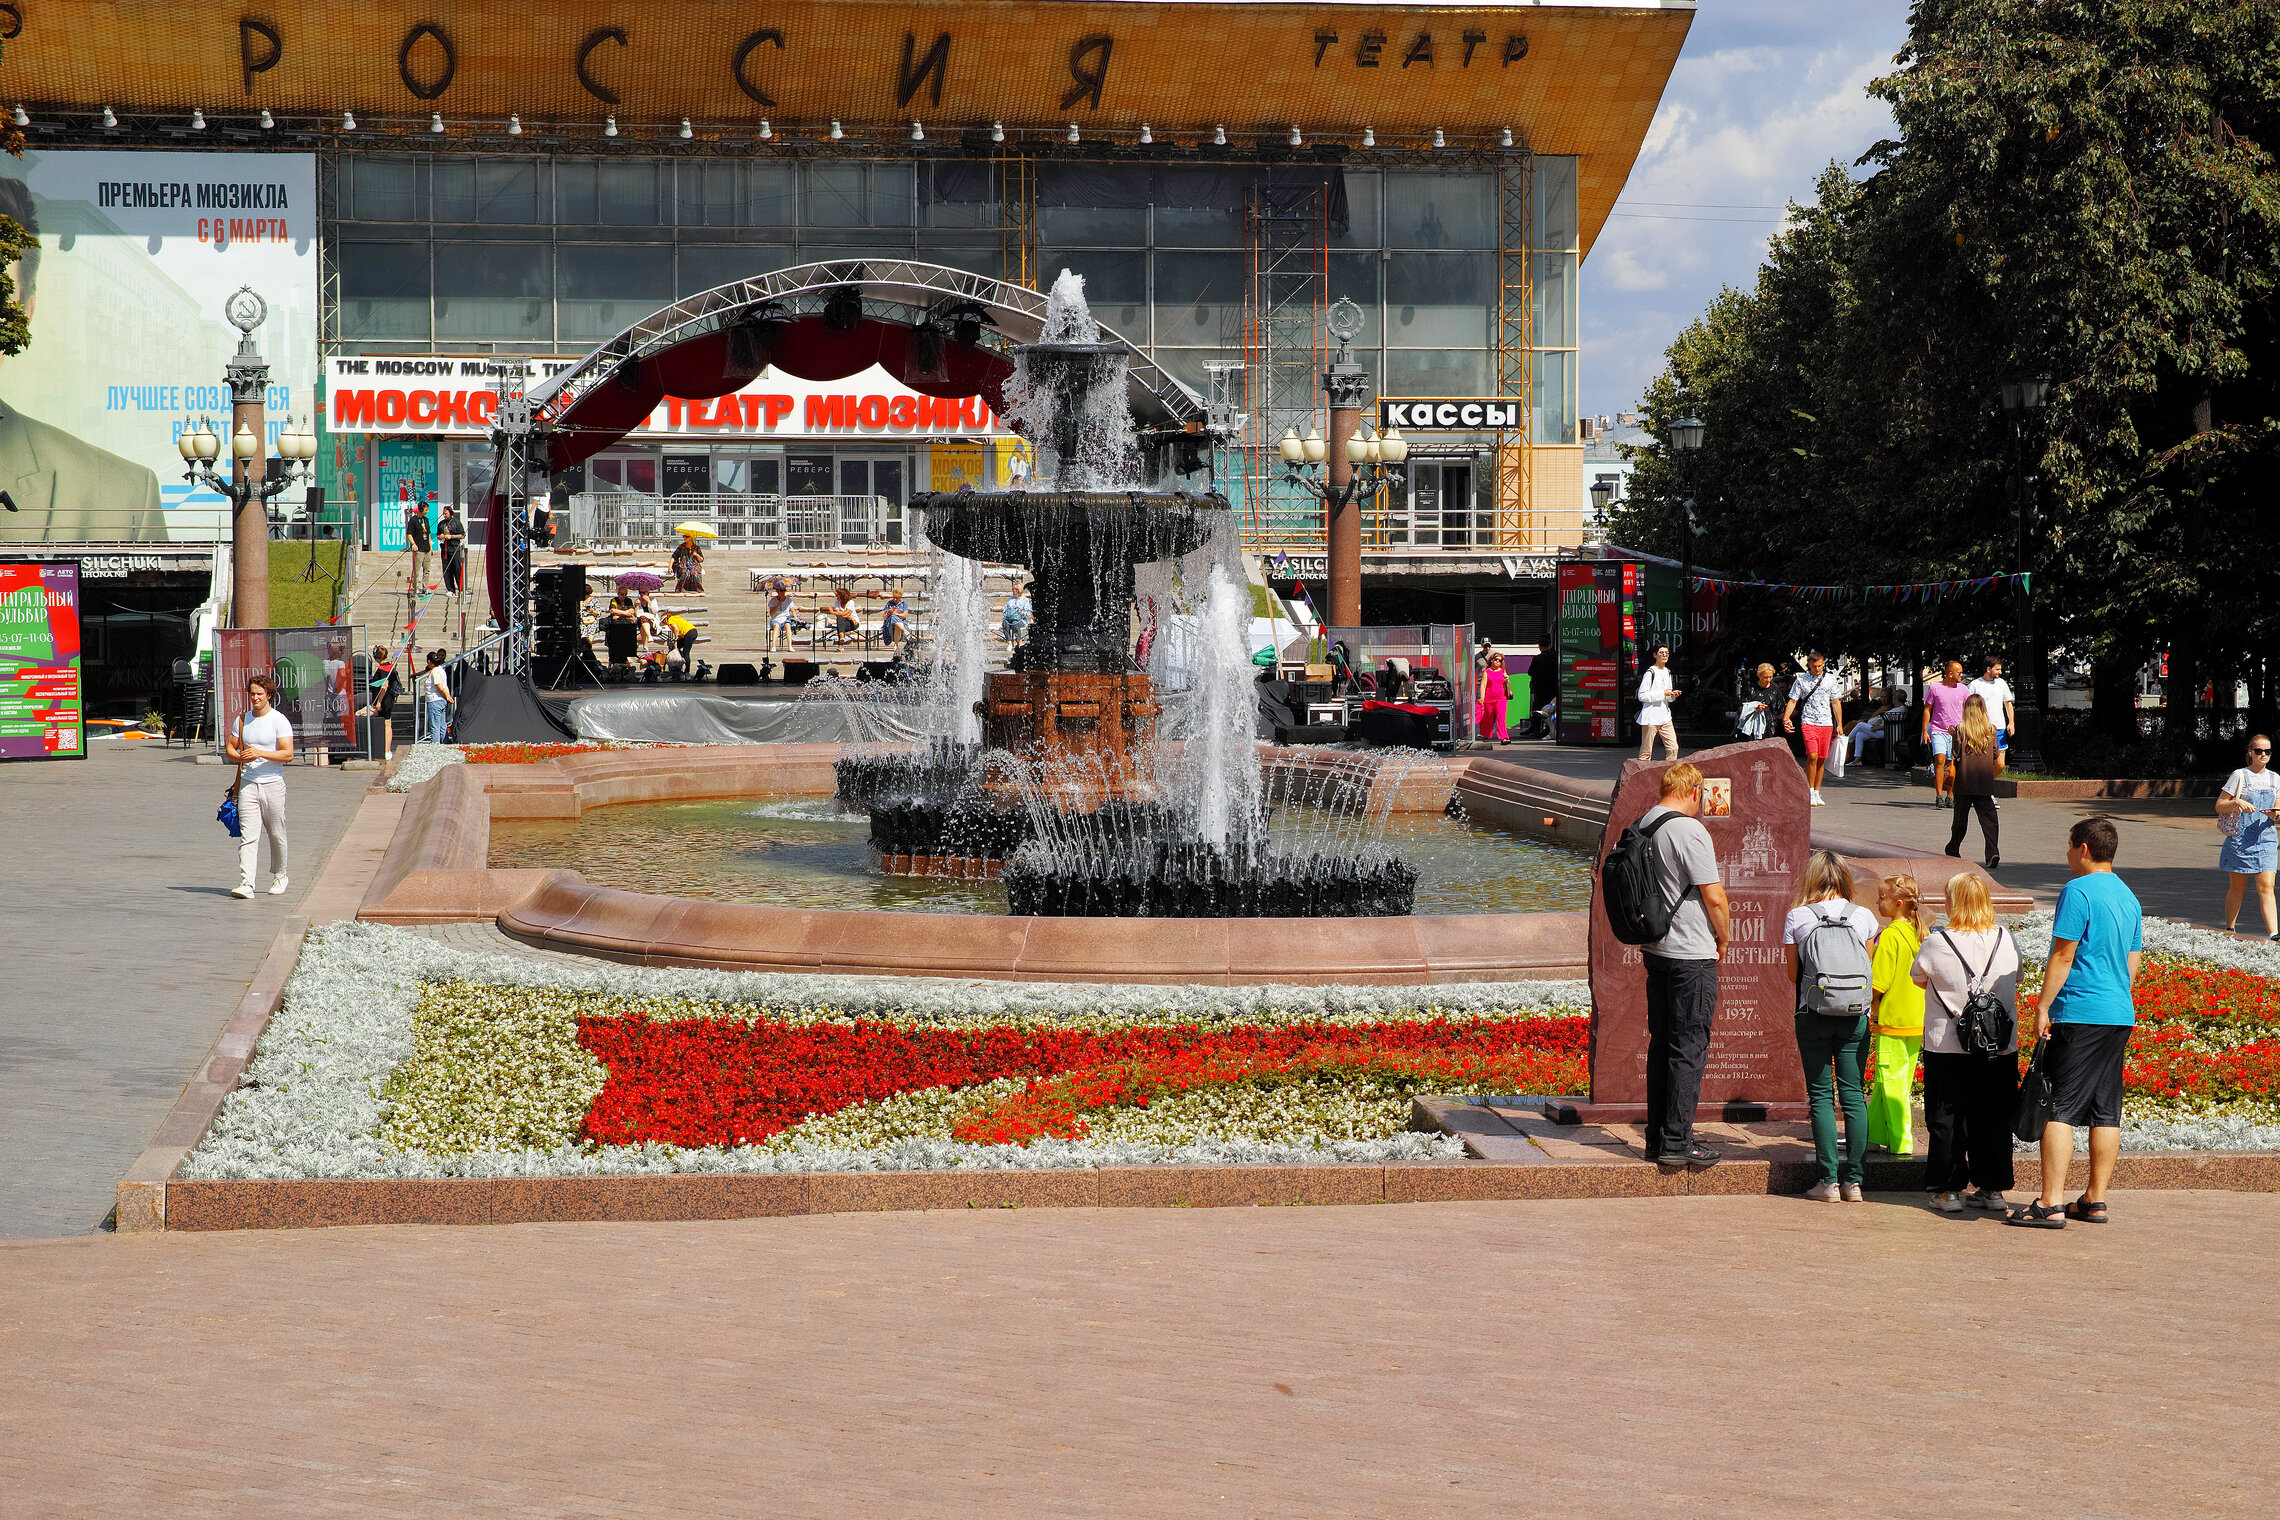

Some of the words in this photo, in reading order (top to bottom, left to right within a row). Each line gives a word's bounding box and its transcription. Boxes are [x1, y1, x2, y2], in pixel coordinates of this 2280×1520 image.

[1314, 29, 1529, 68] ТЕАТР
[98, 182, 192, 208] ПРЕМЬЕРА
[196, 183, 288, 208] МЮЗИКЛА
[197, 218, 208, 243] С
[213, 219, 225, 243] 6
[229, 218, 288, 243] МАРТА
[336, 361, 369, 375] THE
[376, 361, 454, 376] MOSCOW
[107, 385, 179, 411] ЛУЧШЕЕ
[184, 385, 290, 413] СОЗДСЯ
[664, 394, 794, 428] ТЕАТР
[1562, 588, 1616, 604] ТЕАТРАЛЬНЫЙ
[1562, 604, 1598, 619] БУЛЬВАР
[1725, 1007, 1754, 1020] 1937
